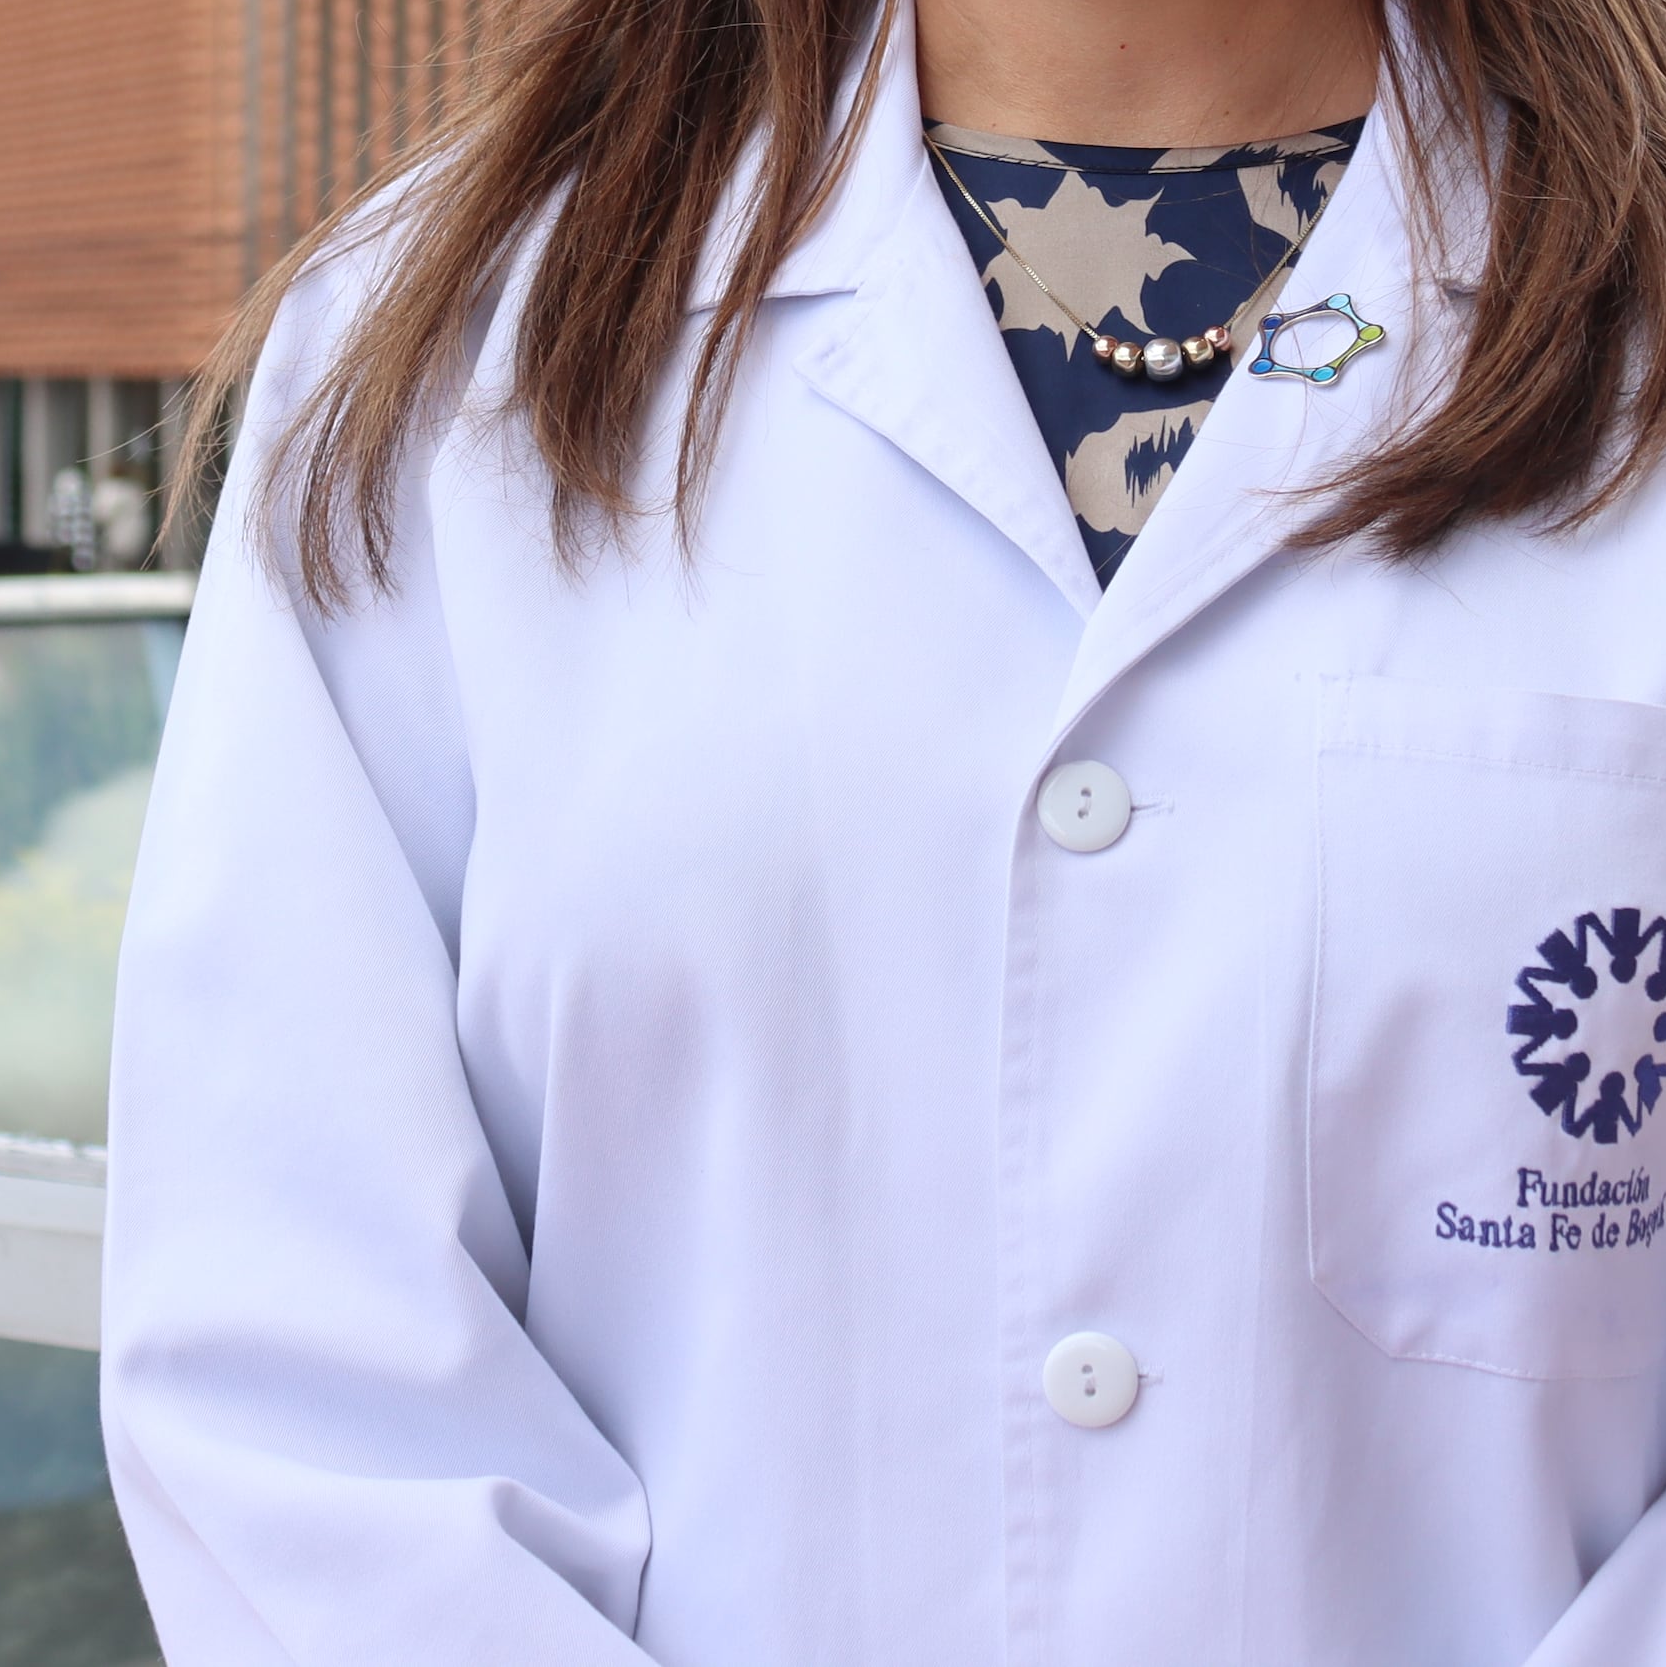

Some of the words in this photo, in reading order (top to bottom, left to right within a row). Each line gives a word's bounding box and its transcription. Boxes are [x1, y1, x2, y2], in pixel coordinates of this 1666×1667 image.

[1517, 1166, 1650, 1208] Fundación
[1436, 1202, 1536, 1249] Santa
[1549, 1213, 1582, 1252] Fe
[1592, 1213, 1620, 1249] de
